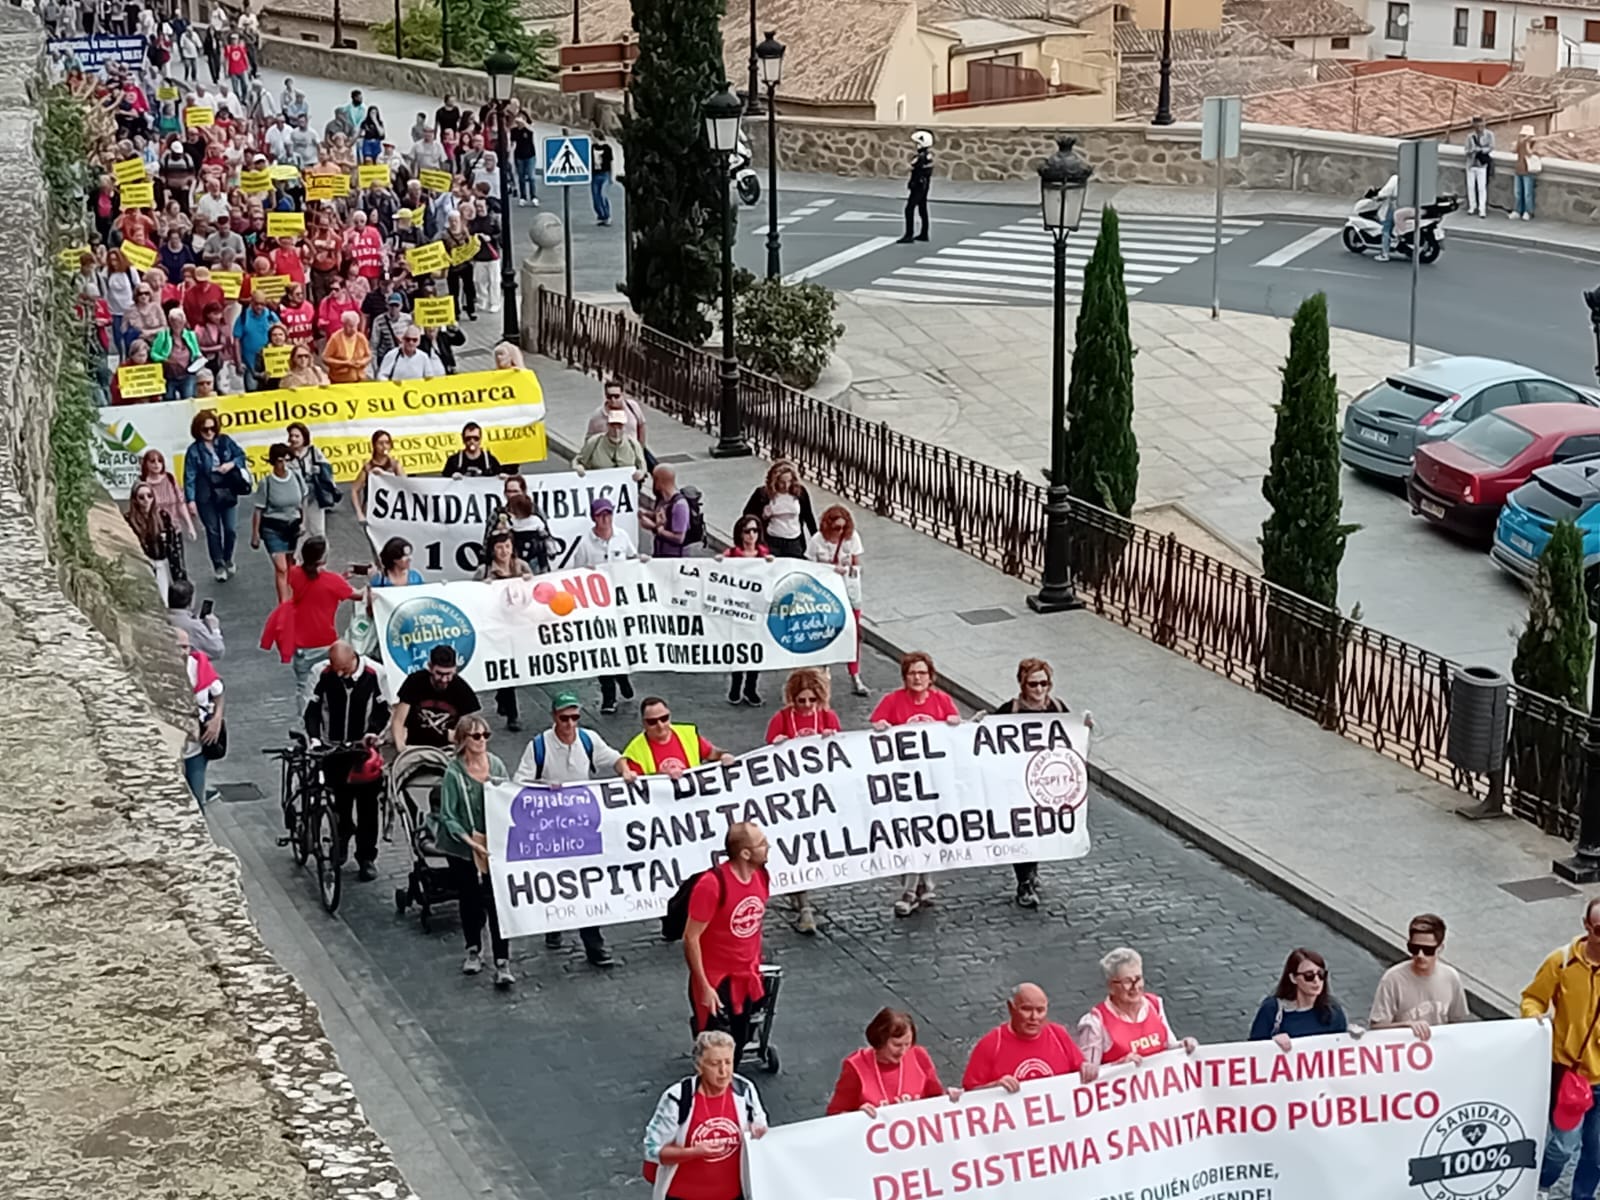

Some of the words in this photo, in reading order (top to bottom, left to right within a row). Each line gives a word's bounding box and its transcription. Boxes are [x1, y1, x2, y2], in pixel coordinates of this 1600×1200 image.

[346, 400, 359, 419] y
[368, 399, 395, 413] su
[403, 385, 516, 410] Comarca
[425, 434, 457, 450] QUE
[531, 480, 634, 520] ÚBLICA
[561, 573, 611, 609] NO
[615, 586, 629, 607] A
[637, 582, 658, 604] LA
[679, 564, 700, 577] LA
[709, 572, 763, 593] SALUD
[401, 623, 461, 652] público
[538, 616, 618, 645] GESTIÓN
[623, 614, 705, 637] PRIVADA
[485, 658, 520, 682] DEL
[528, 647, 621, 677] HOSPITAL
[624, 643, 649, 666] DE
[655, 642, 764, 665] TOMELLOSO
[600, 779, 651, 809] EN
[671, 740, 852, 801] DEFENSA
[869, 730, 947, 764] DEL
[973, 719, 1073, 756] AREA
[626, 782, 837, 852] SANITARIA
[867, 770, 940, 805] DEL
[507, 858, 685, 908] HOSPITAL
[776, 803, 1076, 866] VILLARROBLEDO
[545, 904, 576, 923] POR
[585, 901, 612, 917] UNA
[832, 862, 849, 877] DE
[939, 847, 973, 864] PARA
[865, 1101, 1017, 1155] CONTRA
[1023, 1093, 1066, 1128] EL
[1072, 1041, 1434, 1118] DESMANTELAMIENTO
[1435, 1104, 1512, 1137] SANIDAD
[873, 1168, 944, 1200] DEL
[951, 1136, 1101, 1193] SISTEMA
[1106, 1103, 1278, 1161] SANITARIO
[1287, 1090, 1441, 1131] PÚBLICO
[1440, 1146, 1512, 1177] 100%
[1140, 1176, 1190, 1200] QUIÉN
[1191, 1162, 1280, 1191] GOBIERNE,
